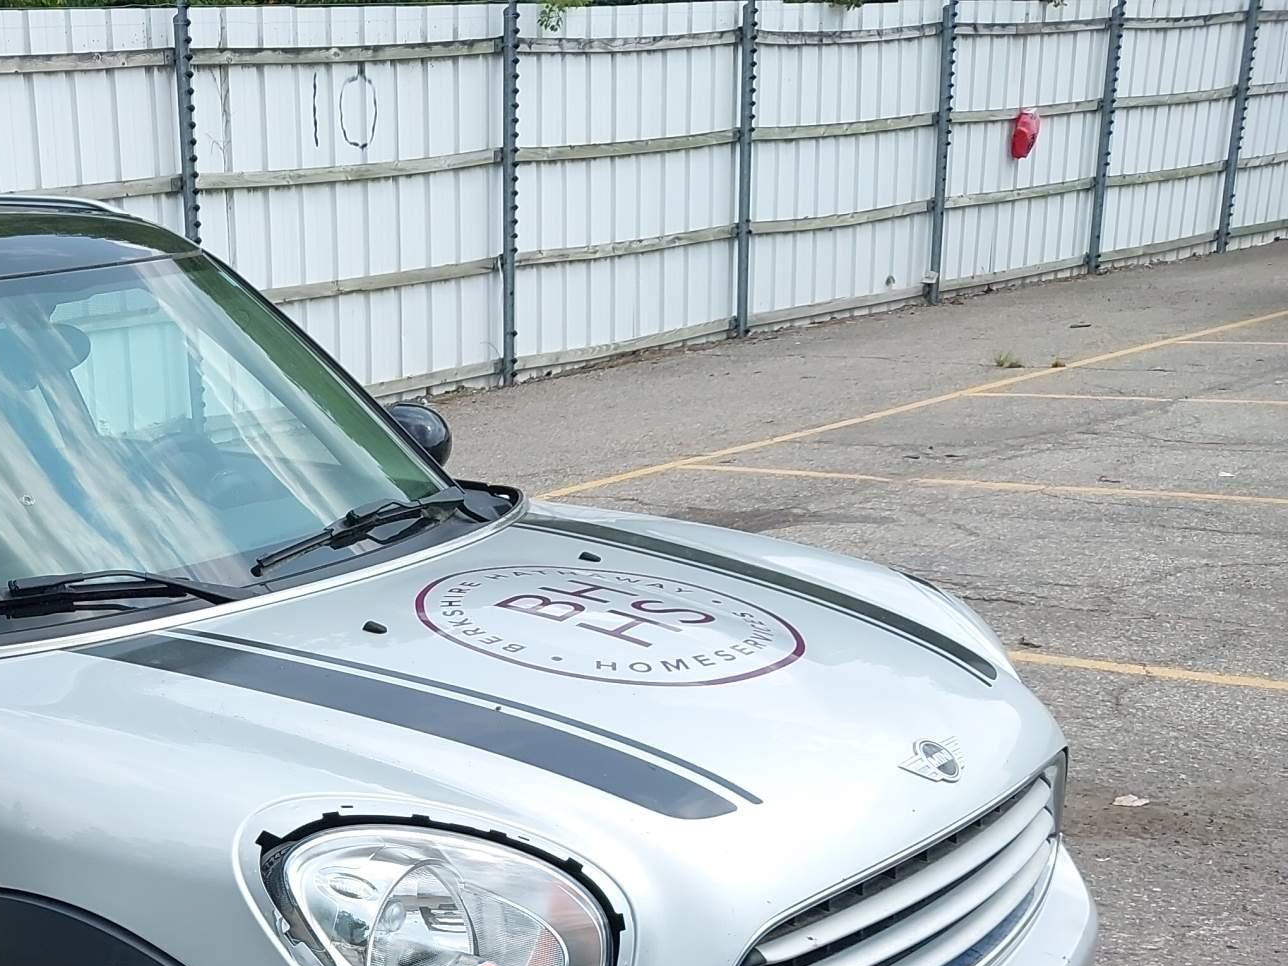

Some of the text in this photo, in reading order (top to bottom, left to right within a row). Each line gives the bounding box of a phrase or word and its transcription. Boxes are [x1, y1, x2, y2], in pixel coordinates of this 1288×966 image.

[312, 71, 378, 152] 10
[439, 579, 527, 654] BERKSHIRE
[494, 578, 639, 623] BH
[575, 598, 717, 649] HS
[595, 610, 776, 674] HOMESERVICES
